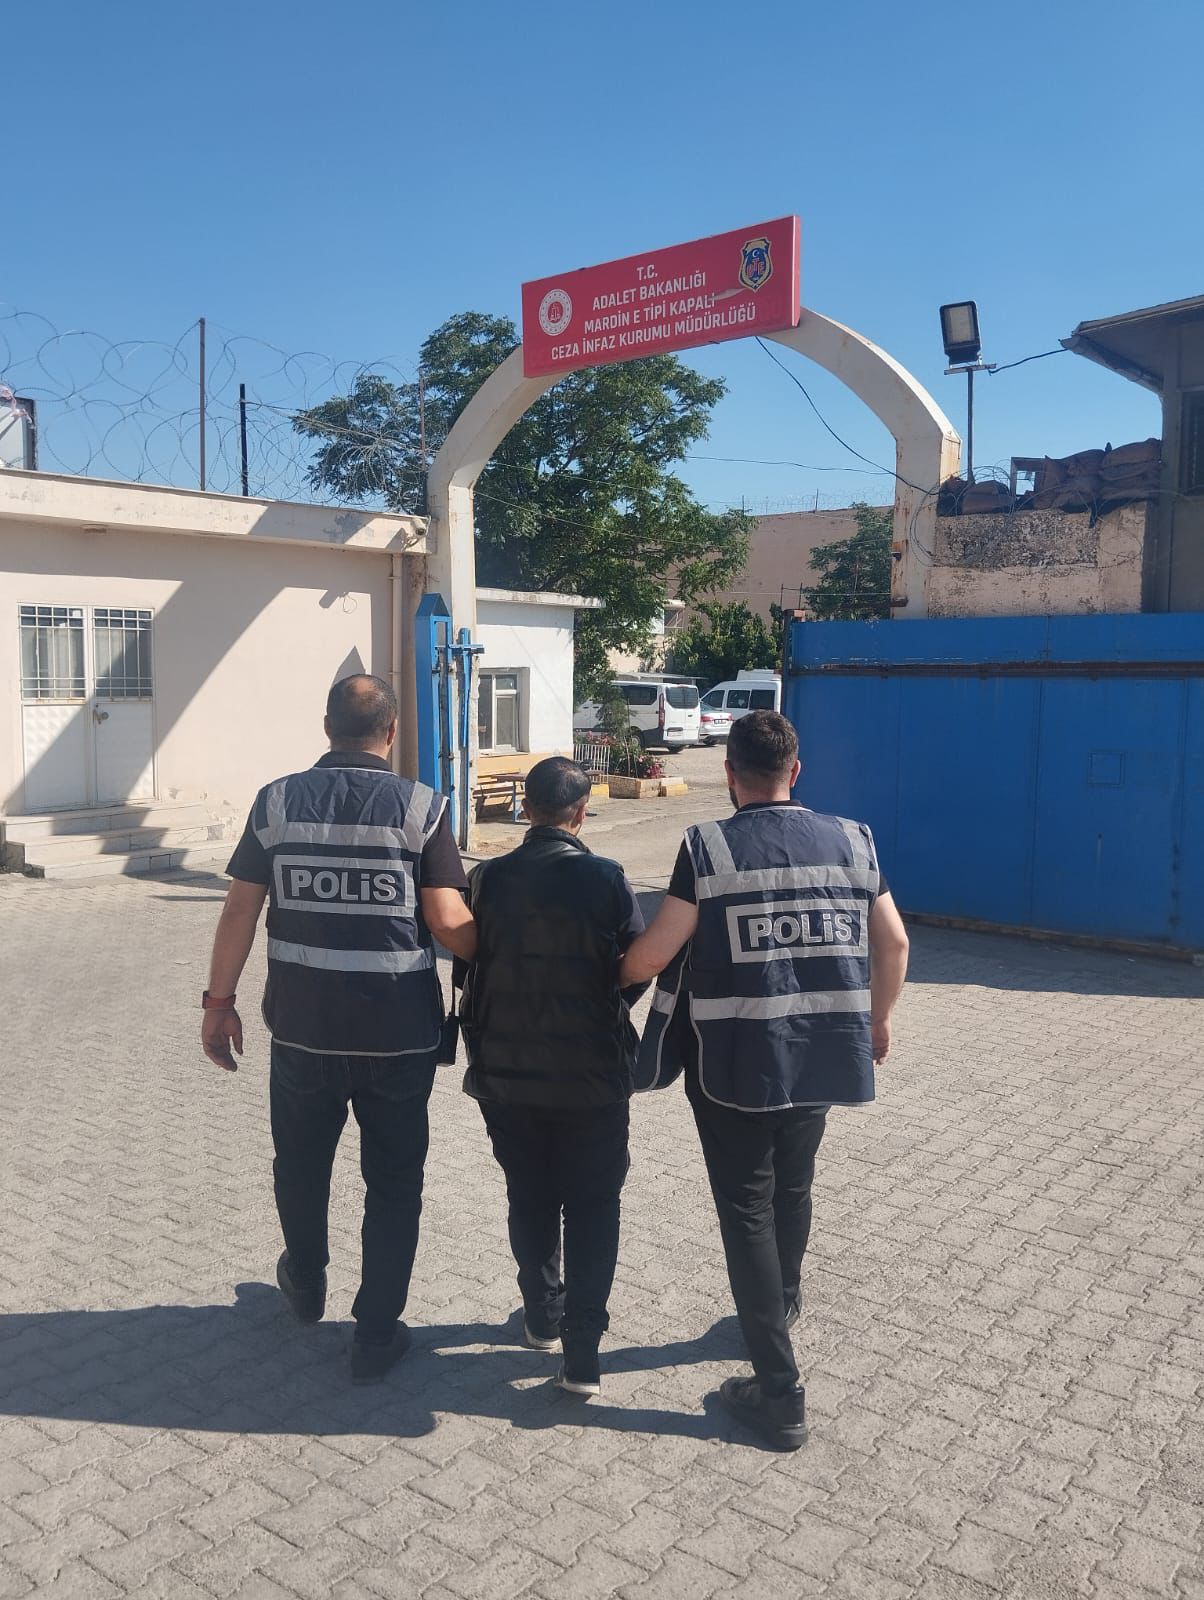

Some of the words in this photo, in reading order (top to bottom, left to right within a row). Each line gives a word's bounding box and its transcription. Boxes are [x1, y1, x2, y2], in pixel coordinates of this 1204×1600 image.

[592, 288, 637, 310] ADALET
[640, 272, 705, 300] BAKANLIĞI
[637, 264, 658, 280] T.C.
[551, 342, 579, 360] CEZA
[583, 335, 615, 354] İNFAZ
[619, 322, 671, 347] KURUMU
[675, 302, 756, 336] MÜDÜRLÜĞÜ
[584, 310, 630, 334] MARDİN
[633, 310, 640, 324] E
[643, 304, 666, 320] TİPİ
[670, 293, 715, 316] KAPALI
